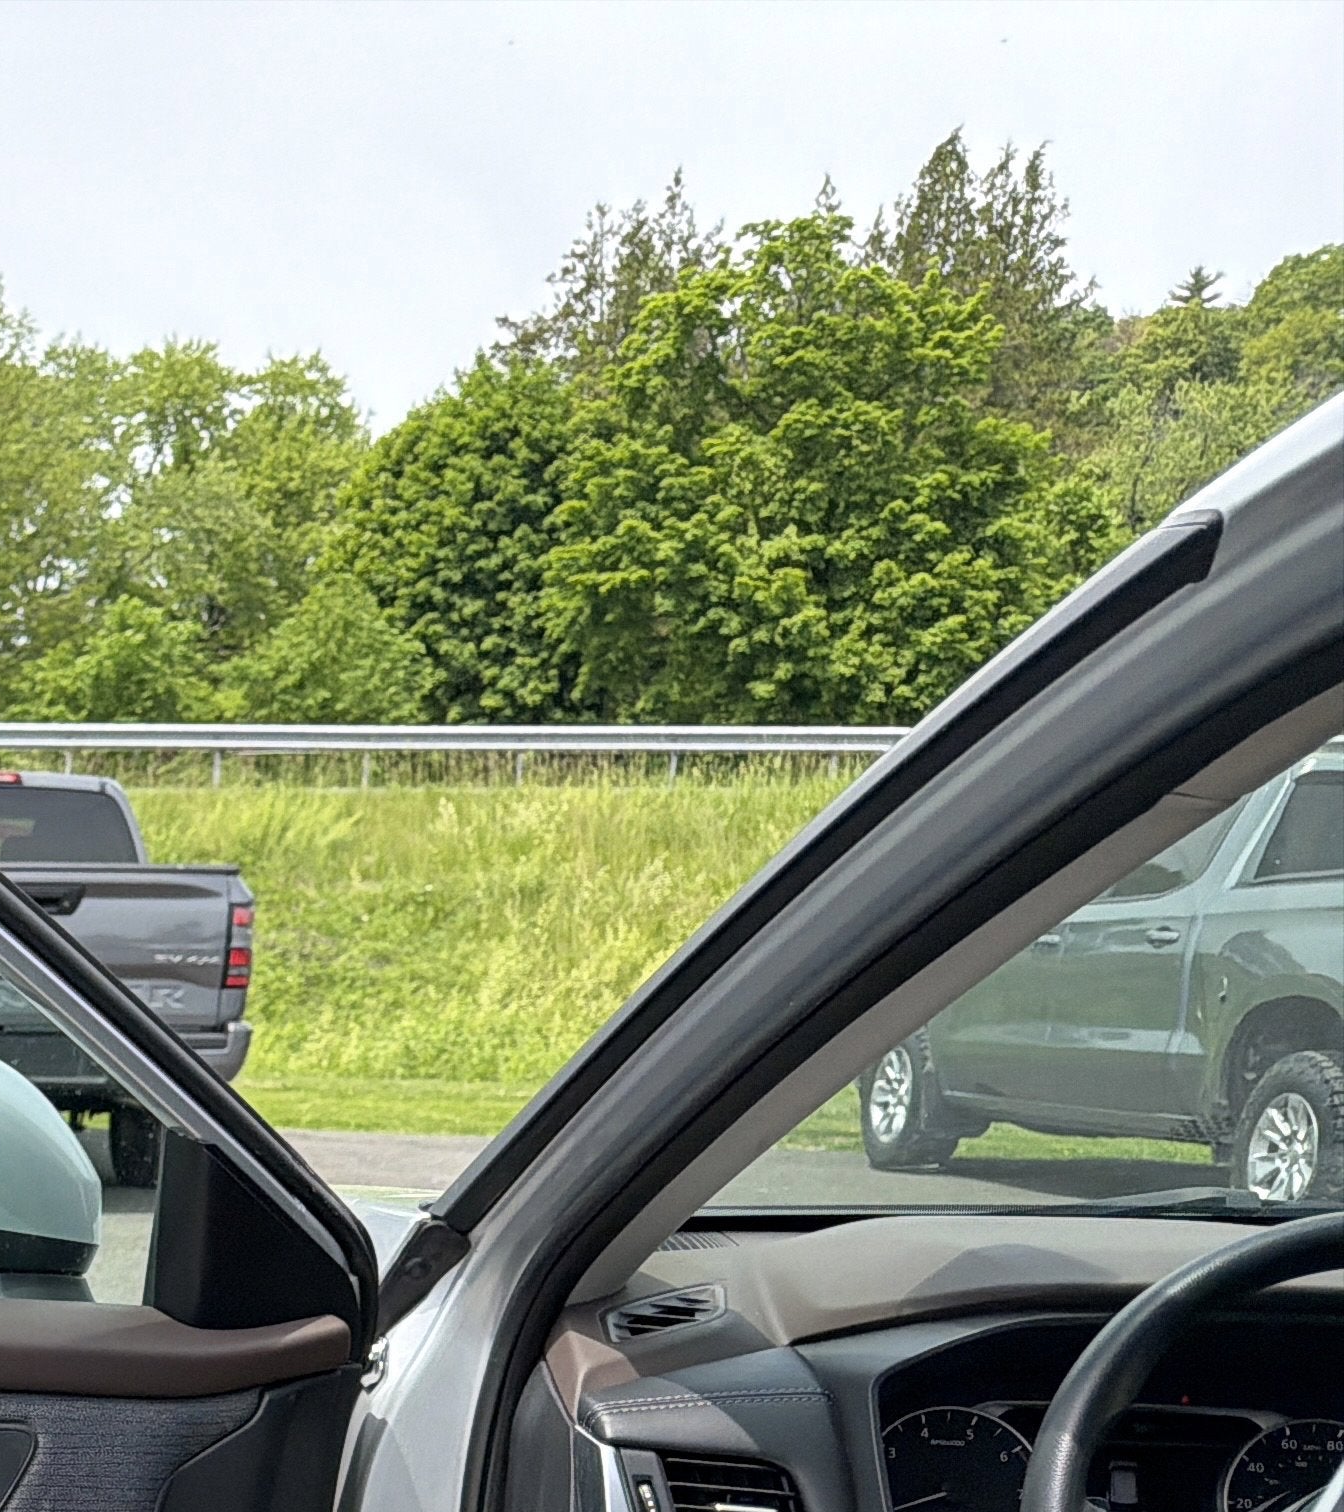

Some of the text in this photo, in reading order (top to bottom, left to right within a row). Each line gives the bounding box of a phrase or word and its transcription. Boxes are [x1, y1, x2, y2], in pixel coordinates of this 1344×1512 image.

[920, 1427, 929, 1438] 4
[966, 1429, 974, 1440] 5
[1281, 1440, 1297, 1449] 60
[1327, 1440, 1343, 1451] 80
[888, 1447, 896, 1459] 3
[999, 1451, 1009, 1462] 6
[1247, 1462, 1265, 1473] 40
[1236, 1498, 1252, 1509] 20
